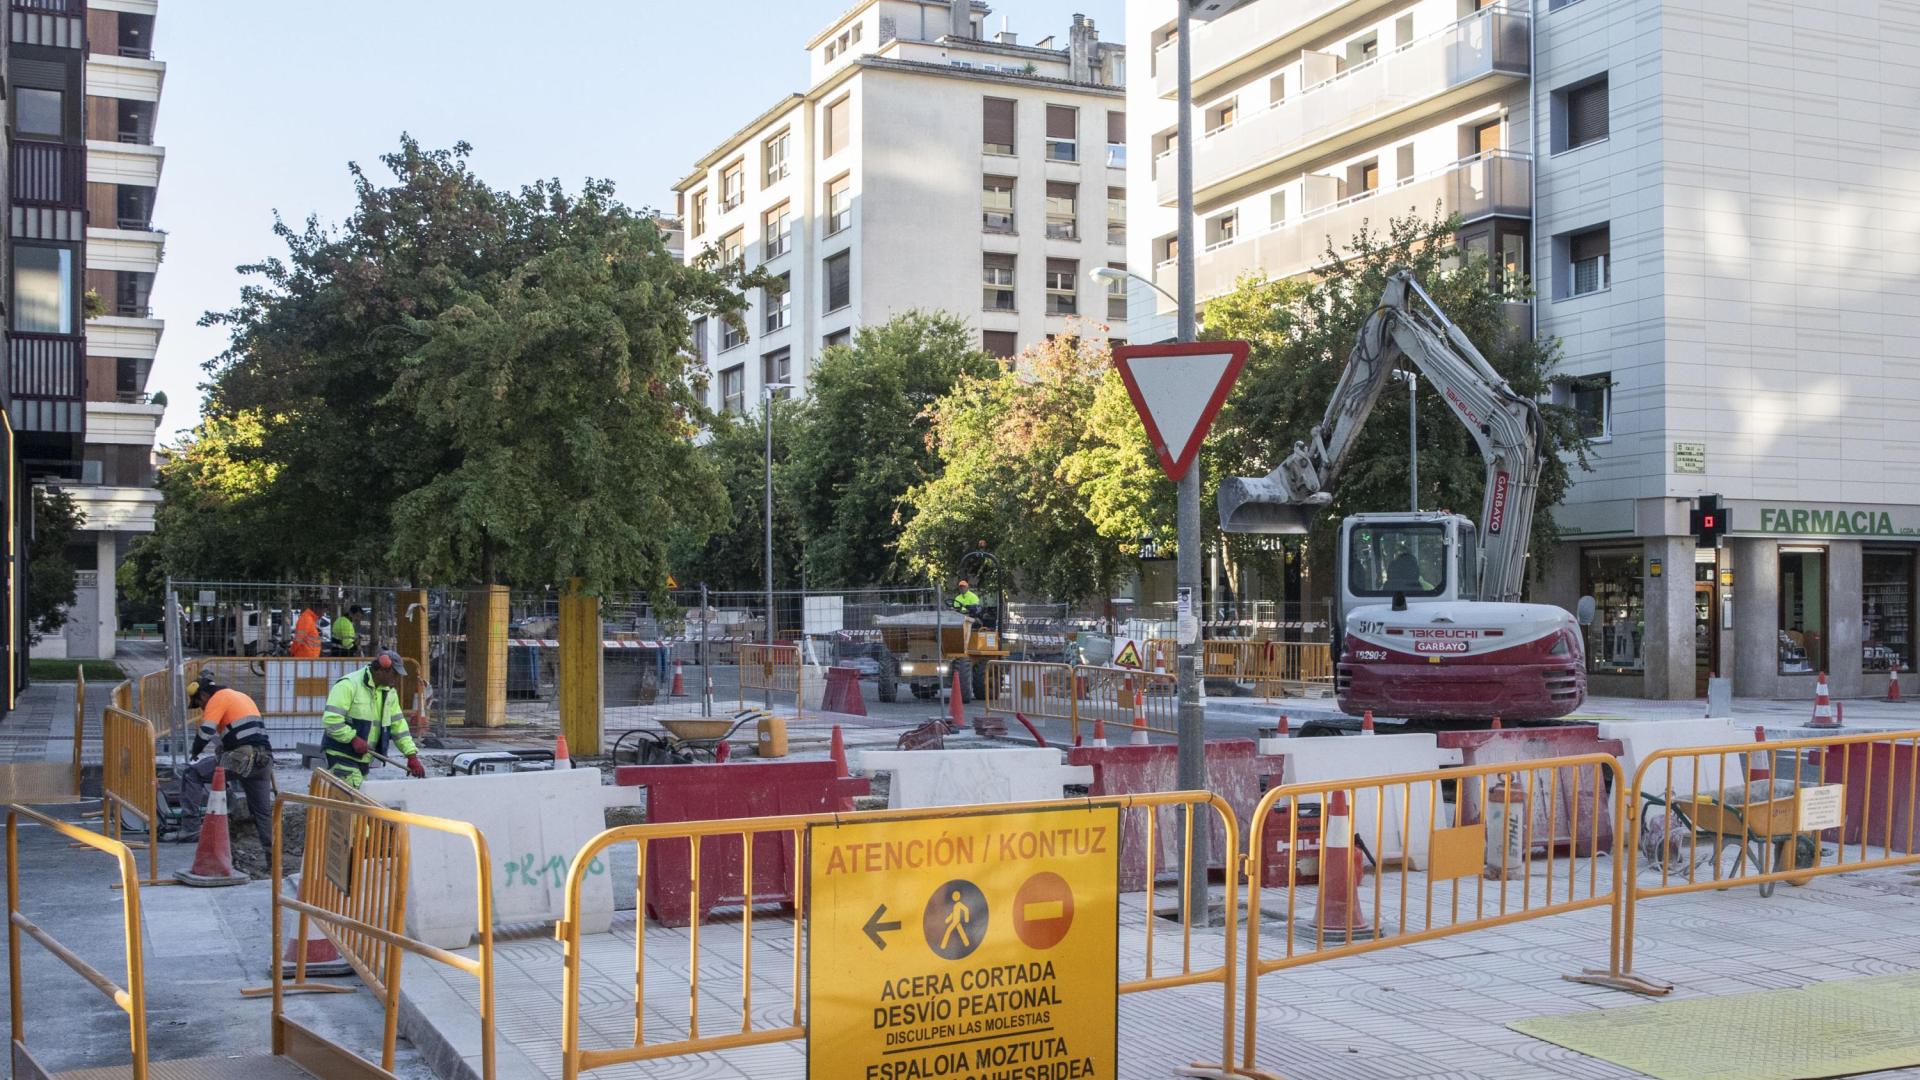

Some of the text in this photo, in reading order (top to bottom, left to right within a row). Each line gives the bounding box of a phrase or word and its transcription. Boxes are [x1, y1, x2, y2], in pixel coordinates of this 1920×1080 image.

[1491, 475, 1507, 532] GARBAYO
[1760, 508, 1894, 535] FARMACIA
[1359, 621, 1385, 634] 507
[1417, 642, 1467, 652] GARBAYO
[825, 826, 1107, 875] ATENCIÓN / KONTUZ
[880, 960, 1056, 1001] ACERA CORTADA
[873, 985, 1062, 1029] DESVÍO PEATONAL
[886, 1011, 1051, 1046] DISCULPEN LAS MOLESTIAS
[866, 1037, 1068, 1080] ESPALOIA MOZTUTA
